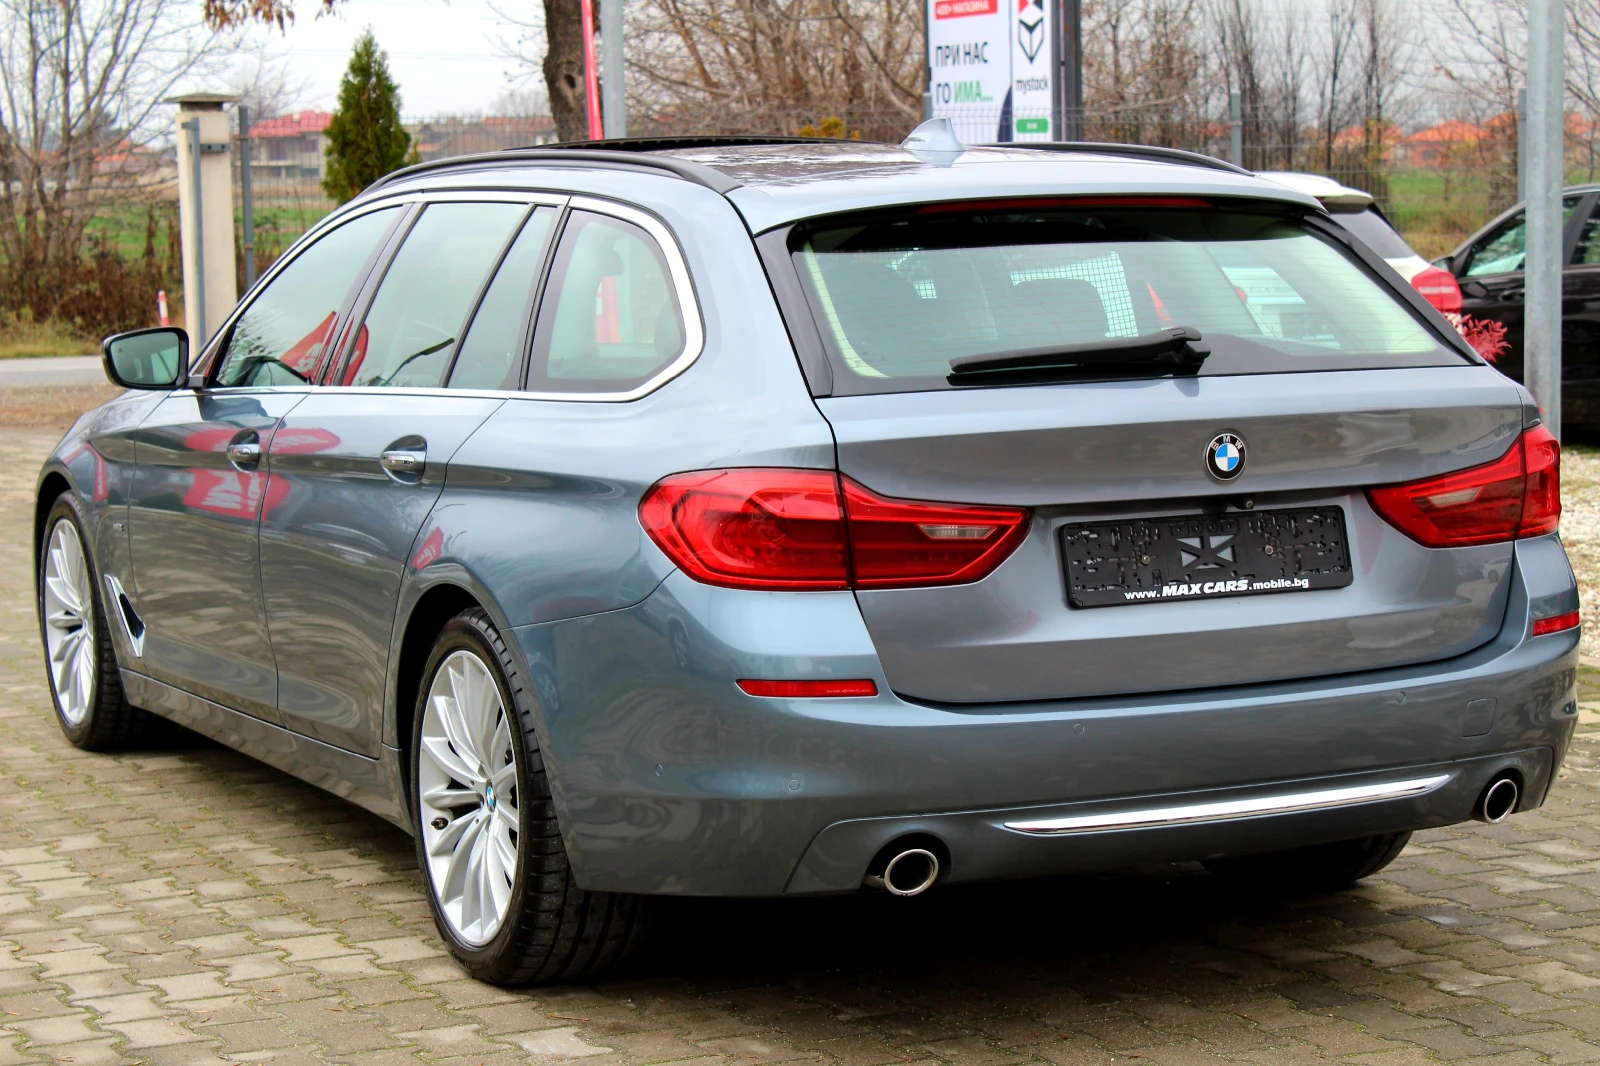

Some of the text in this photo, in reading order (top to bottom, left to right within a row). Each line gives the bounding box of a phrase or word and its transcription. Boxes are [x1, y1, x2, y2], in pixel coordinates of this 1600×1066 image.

[935, 41, 988, 67] ПРИ НАС
[936, 83, 950, 104] ГО
[1210, 435, 1243, 451] BMW
